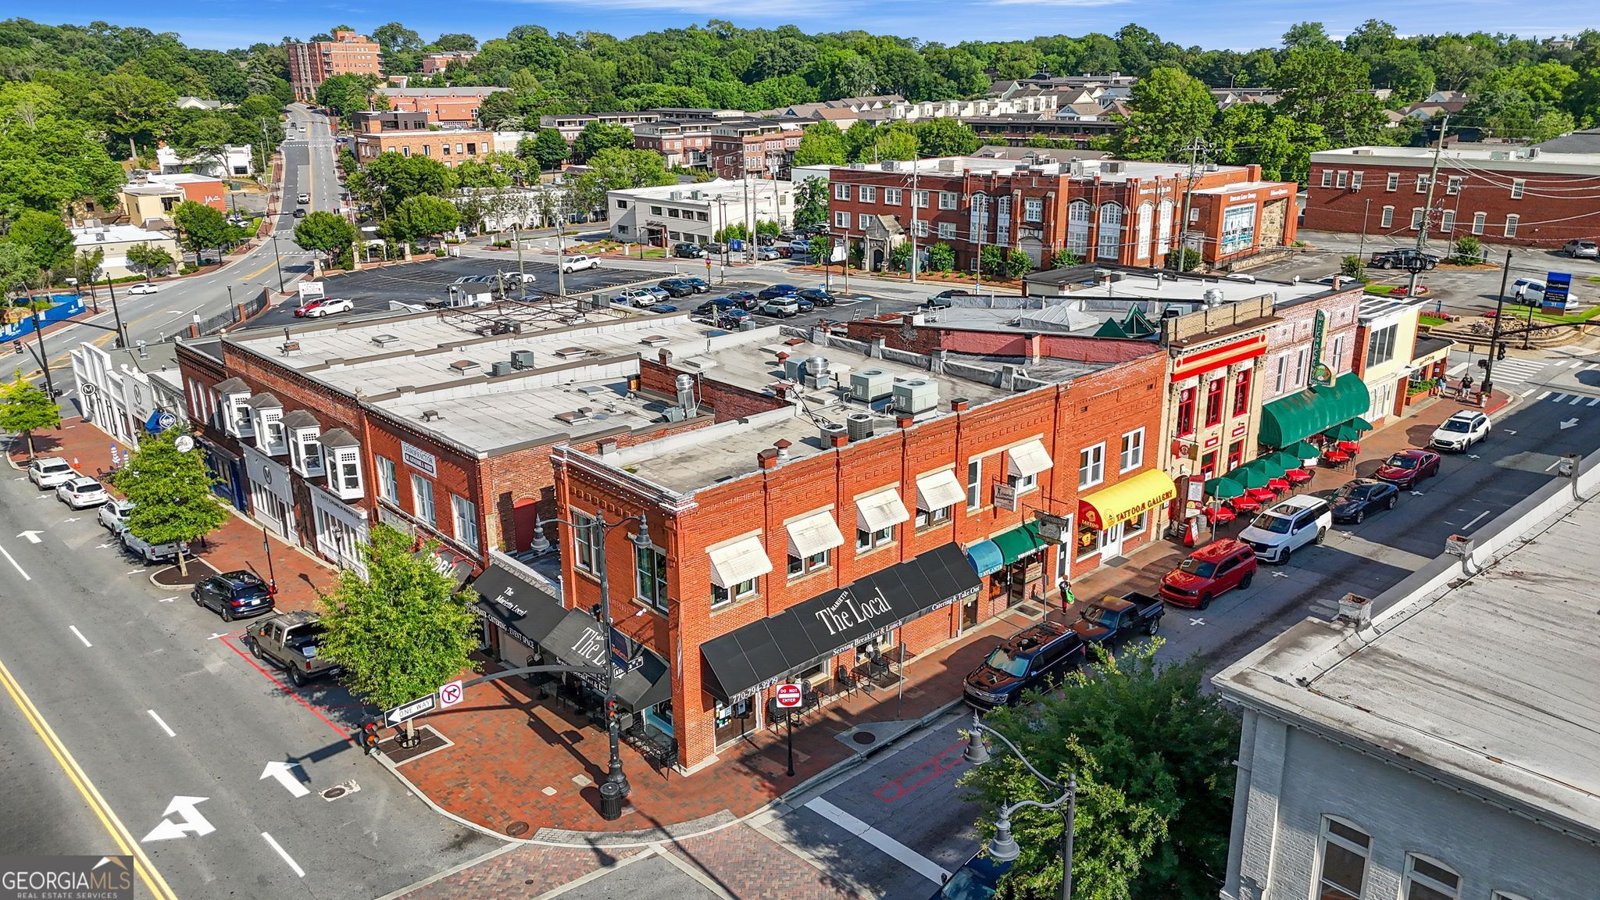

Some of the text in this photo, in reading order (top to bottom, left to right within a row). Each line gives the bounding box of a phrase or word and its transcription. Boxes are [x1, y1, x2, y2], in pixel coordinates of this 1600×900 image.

[1147, 490, 1173, 508] GALLERY
[815, 586, 892, 636] The Local
[830, 590, 849, 612] MARIETTA
[931, 599, 952, 611] Catering
[958, 591, 970, 601] Take
[970, 585, 980, 594] Out
[571, 626, 600, 660] The
[832, 641, 854, 656] Serving
[854, 629, 880, 646] Breakfast
[885, 619, 903, 633] Lunch
[399, 700, 431, 718] ONE WAY
